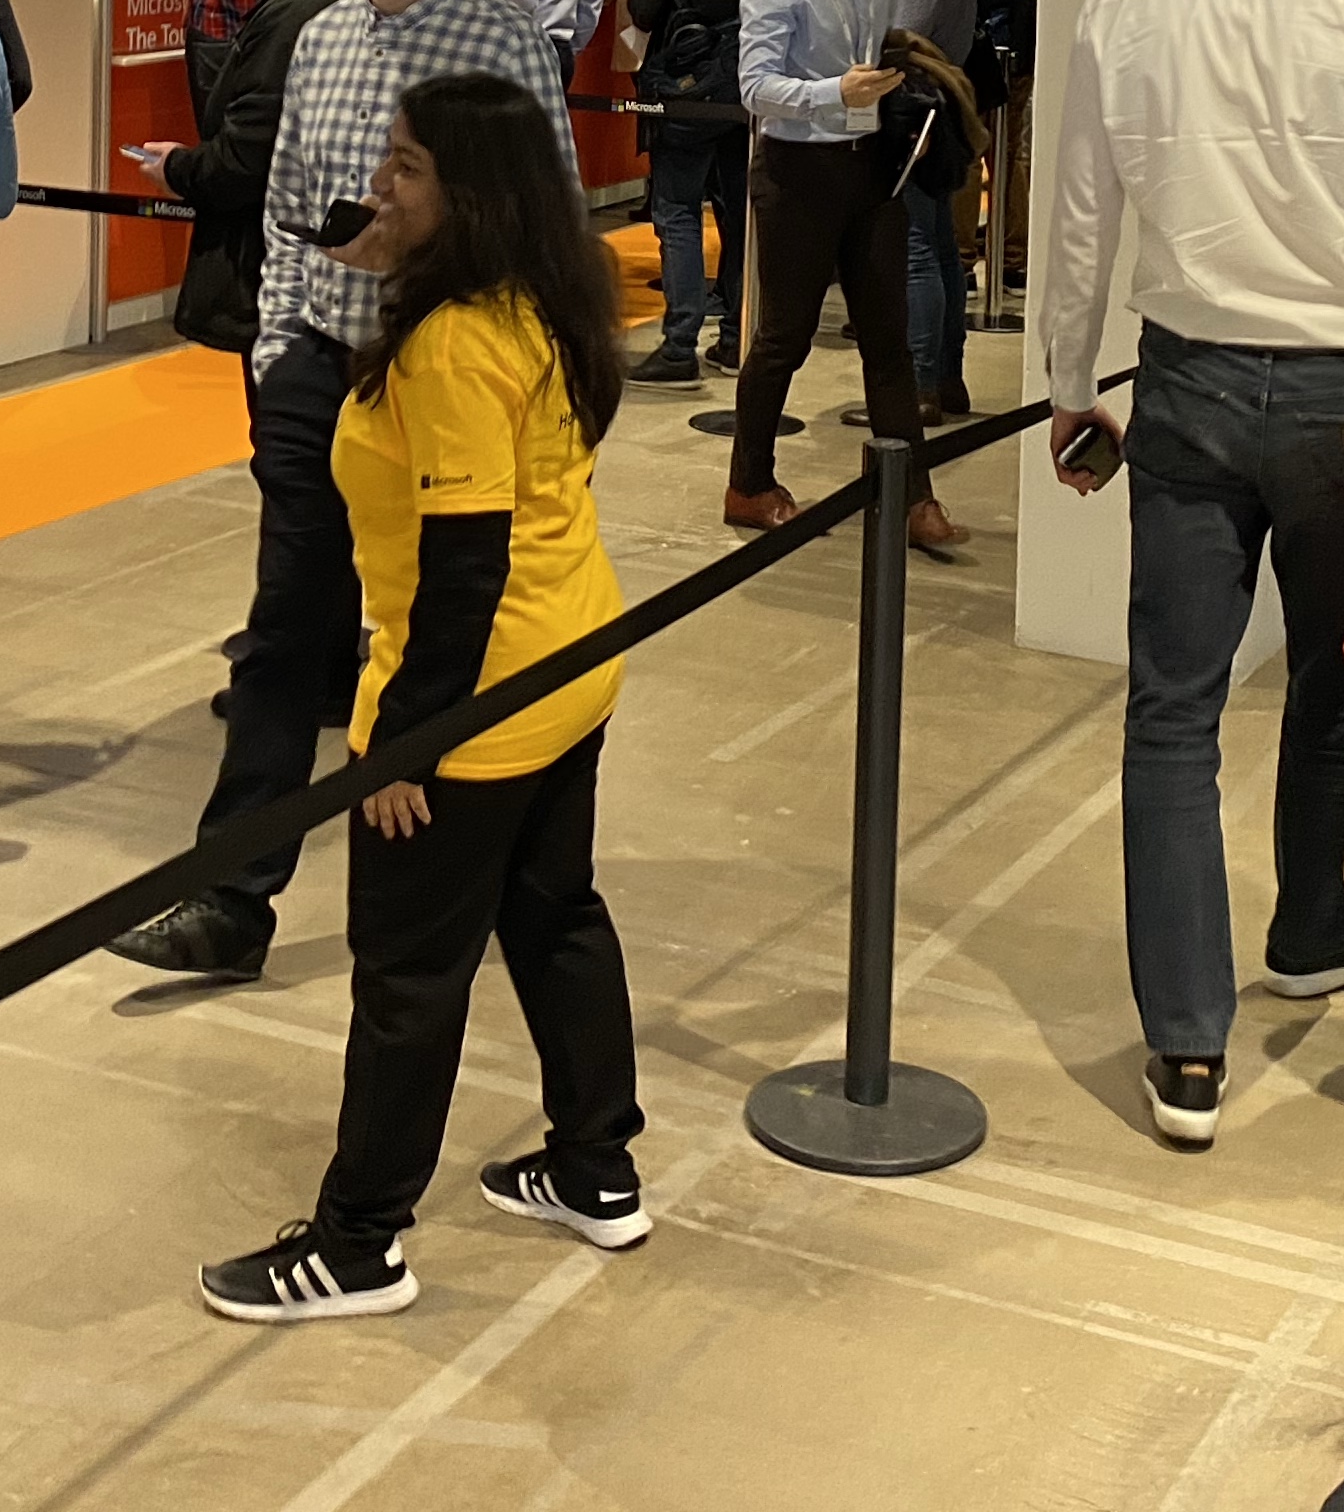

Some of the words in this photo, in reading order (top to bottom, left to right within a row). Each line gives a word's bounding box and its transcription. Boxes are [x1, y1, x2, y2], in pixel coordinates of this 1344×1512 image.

[125, 26, 156, 51] The
[160, 23, 186, 48] Tou
[624, 99, 665, 114] Microsoft
[18, 188, 46, 202] rosoft
[154, 201, 197, 219] Microso
